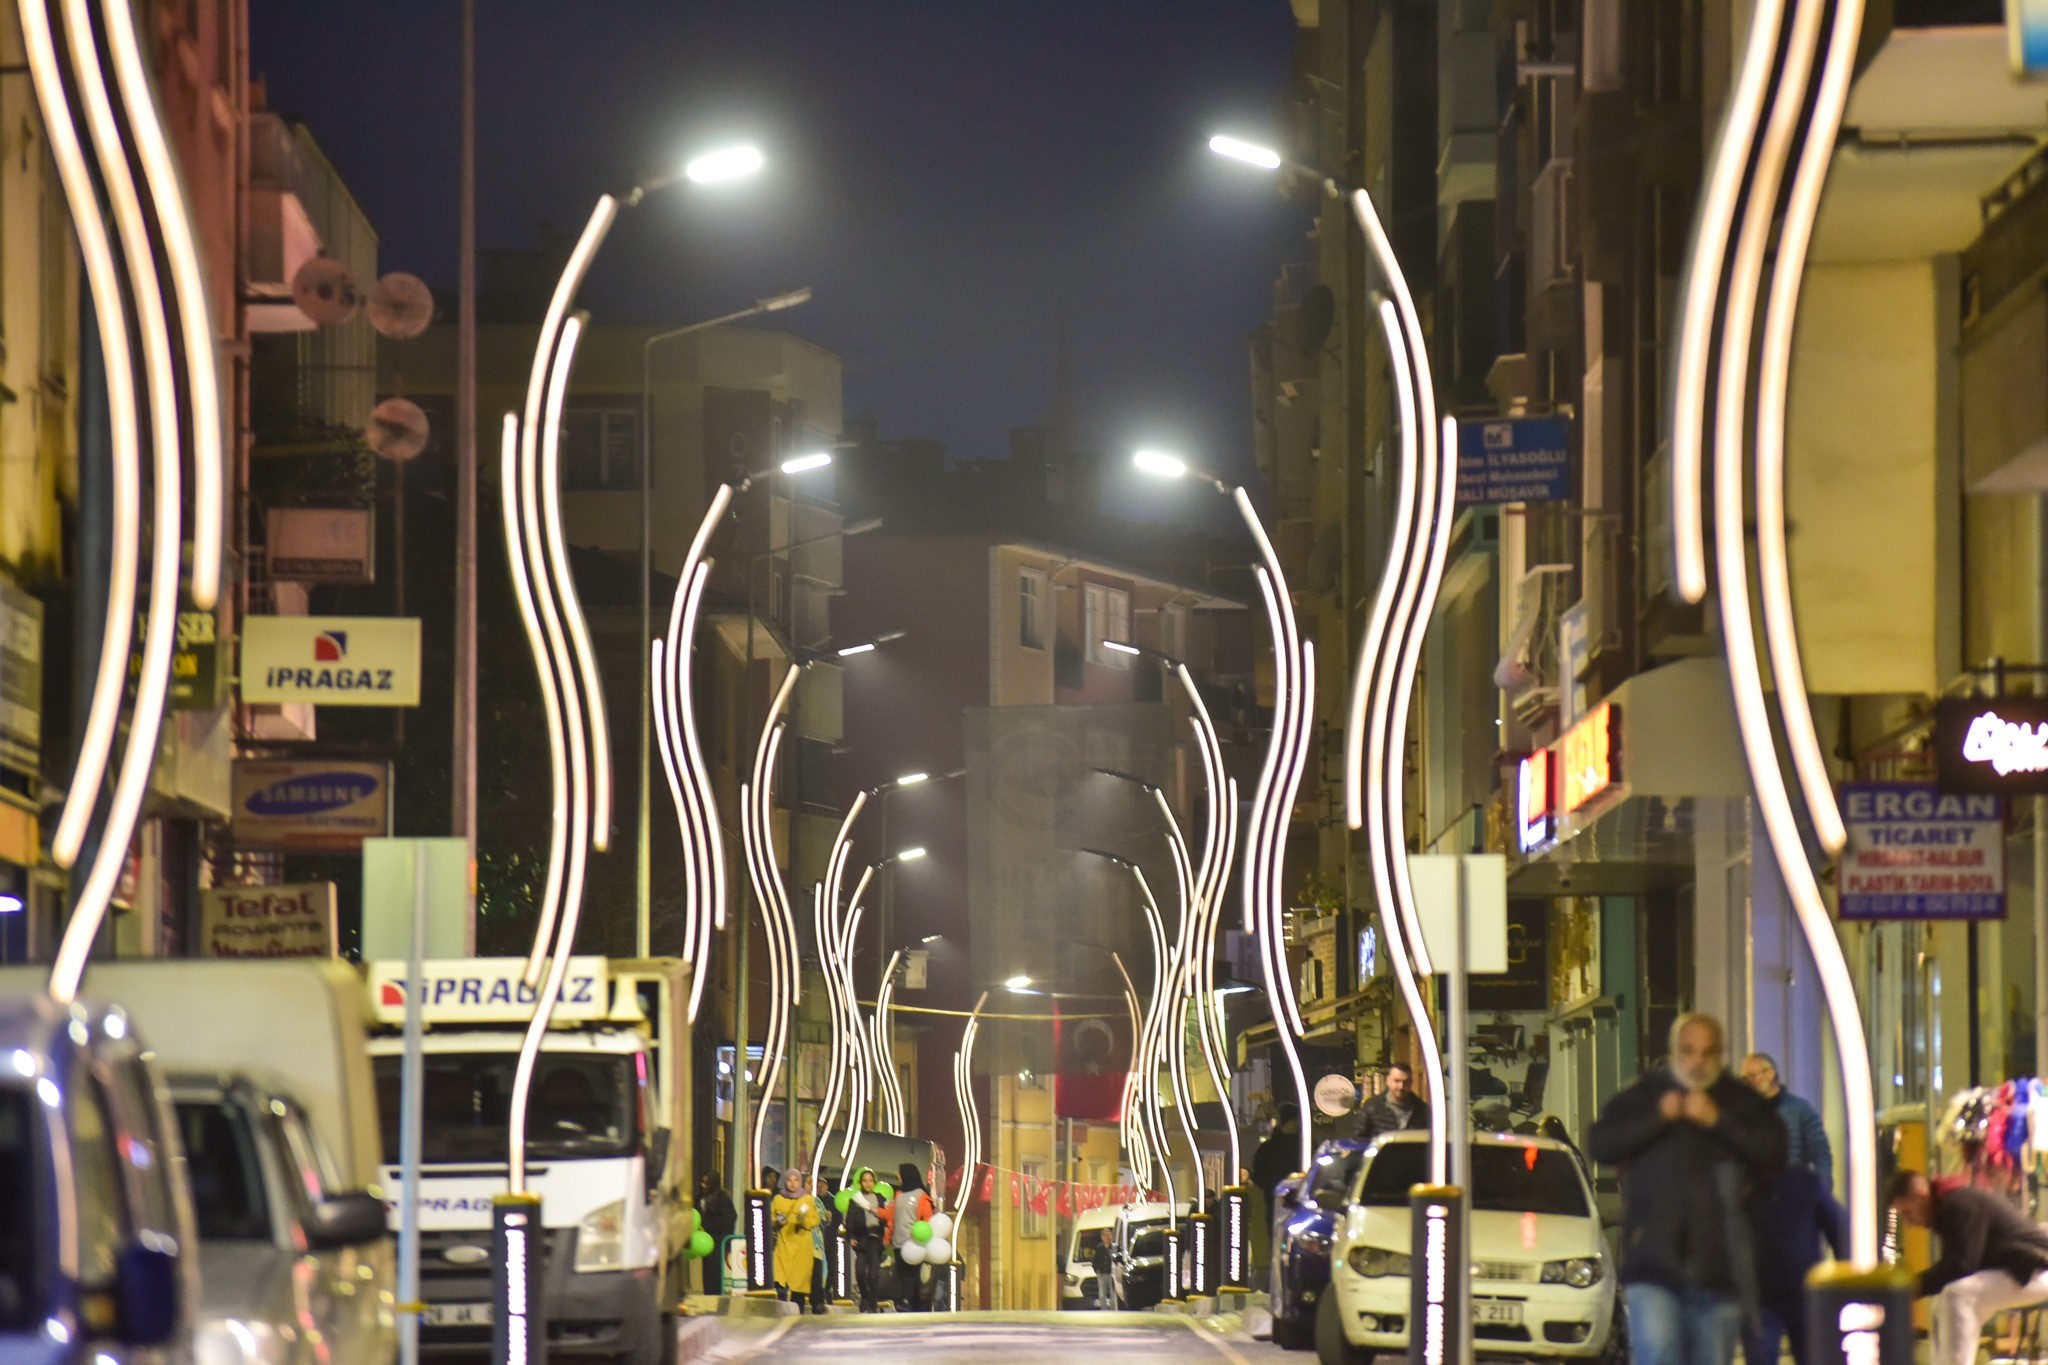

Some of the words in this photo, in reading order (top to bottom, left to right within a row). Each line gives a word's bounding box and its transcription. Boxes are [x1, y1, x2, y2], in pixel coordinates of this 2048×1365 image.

[260, 784, 363, 803] SAMSUNG
[1847, 790, 1996, 820] ERGAN
[1869, 826, 1975, 845] TİCARET
[219, 891, 316, 920] Tefal
[1488, 1305, 1515, 1320] 211
